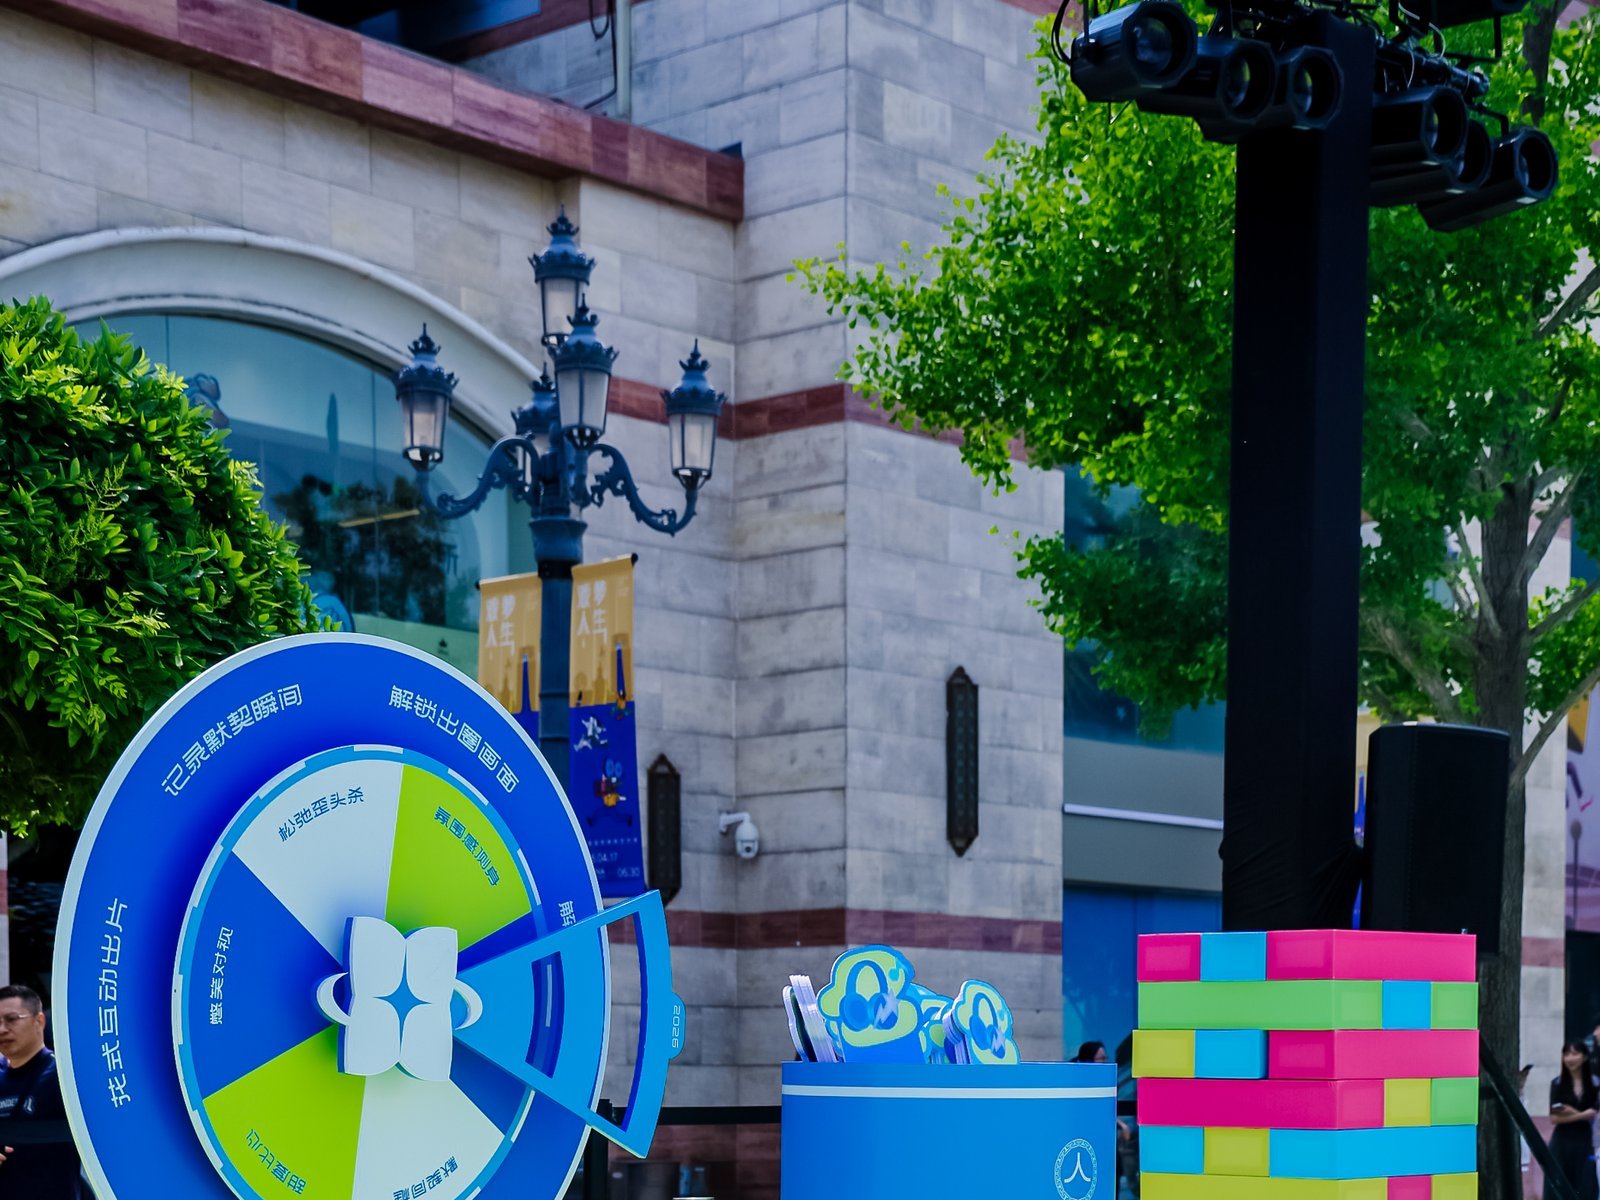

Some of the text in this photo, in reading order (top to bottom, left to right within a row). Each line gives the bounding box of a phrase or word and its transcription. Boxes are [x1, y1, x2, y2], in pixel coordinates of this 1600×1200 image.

[160, 684, 303, 798] 记录默契瞬间
[387, 684, 520, 795] 解锁出圈画面
[277, 786, 365, 843] 松弛歪头杀
[98, 897, 131, 1109] 花式互动出片
[209, 926, 234, 1026] 憋笑对视
[671, 1004, 682, 1049] 2026
[245, 1128, 307, 1196] 甜度比心
